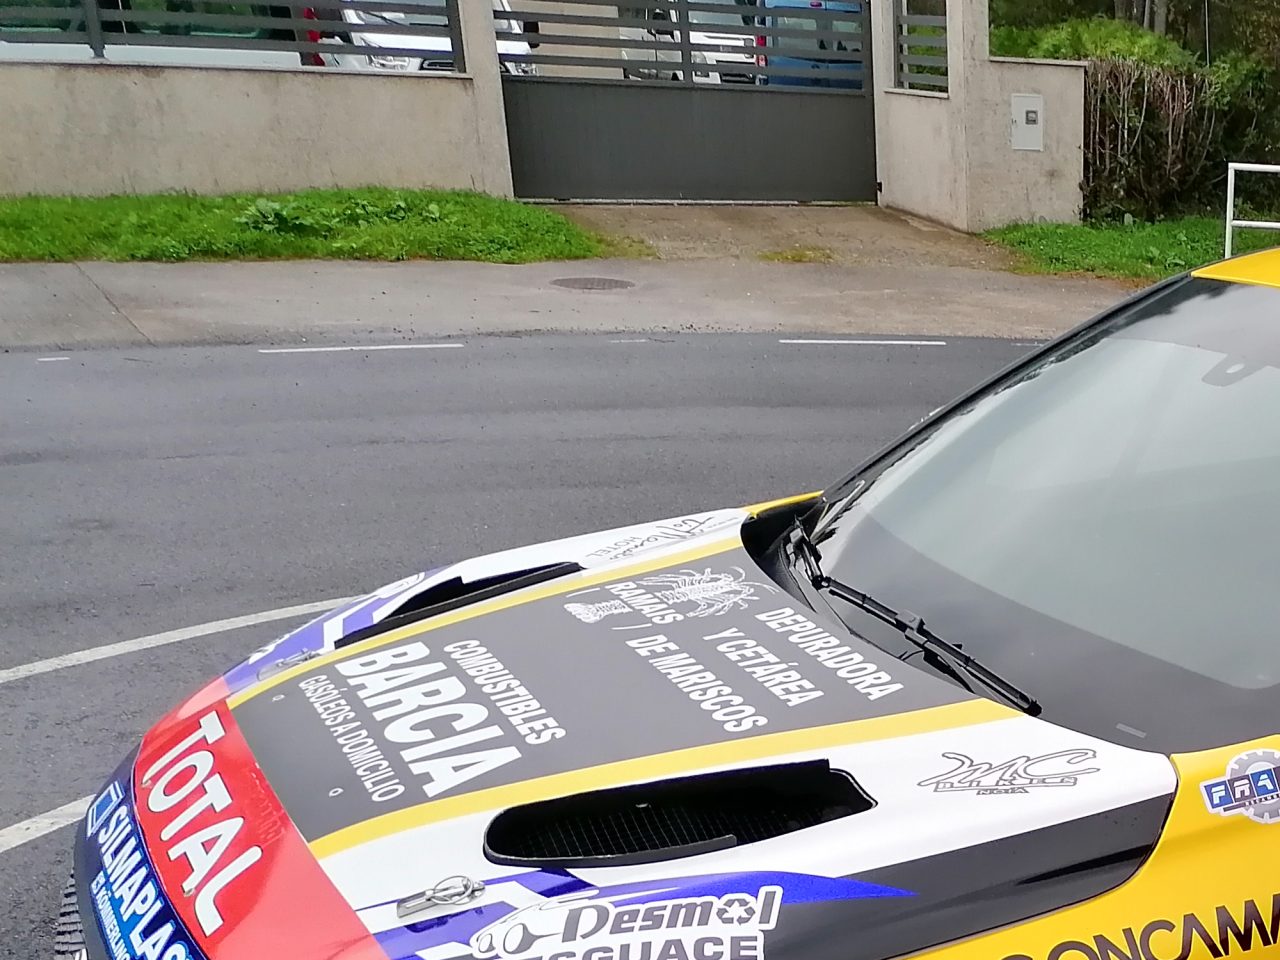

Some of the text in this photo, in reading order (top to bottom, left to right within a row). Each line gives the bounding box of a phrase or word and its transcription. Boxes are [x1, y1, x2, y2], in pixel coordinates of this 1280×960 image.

[444, 639, 567, 746] COMBUSTIBLES
[625, 633, 769, 734] DE MARISCOS
[702, 627, 825, 709] Y CETÁREA
[755, 606, 904, 702] DEPURADORA
[298, 674, 406, 802] GASÓLEOS A DOMICILIO
[335, 641, 522, 798] BARCIA
[140, 710, 264, 938] TOTAL
